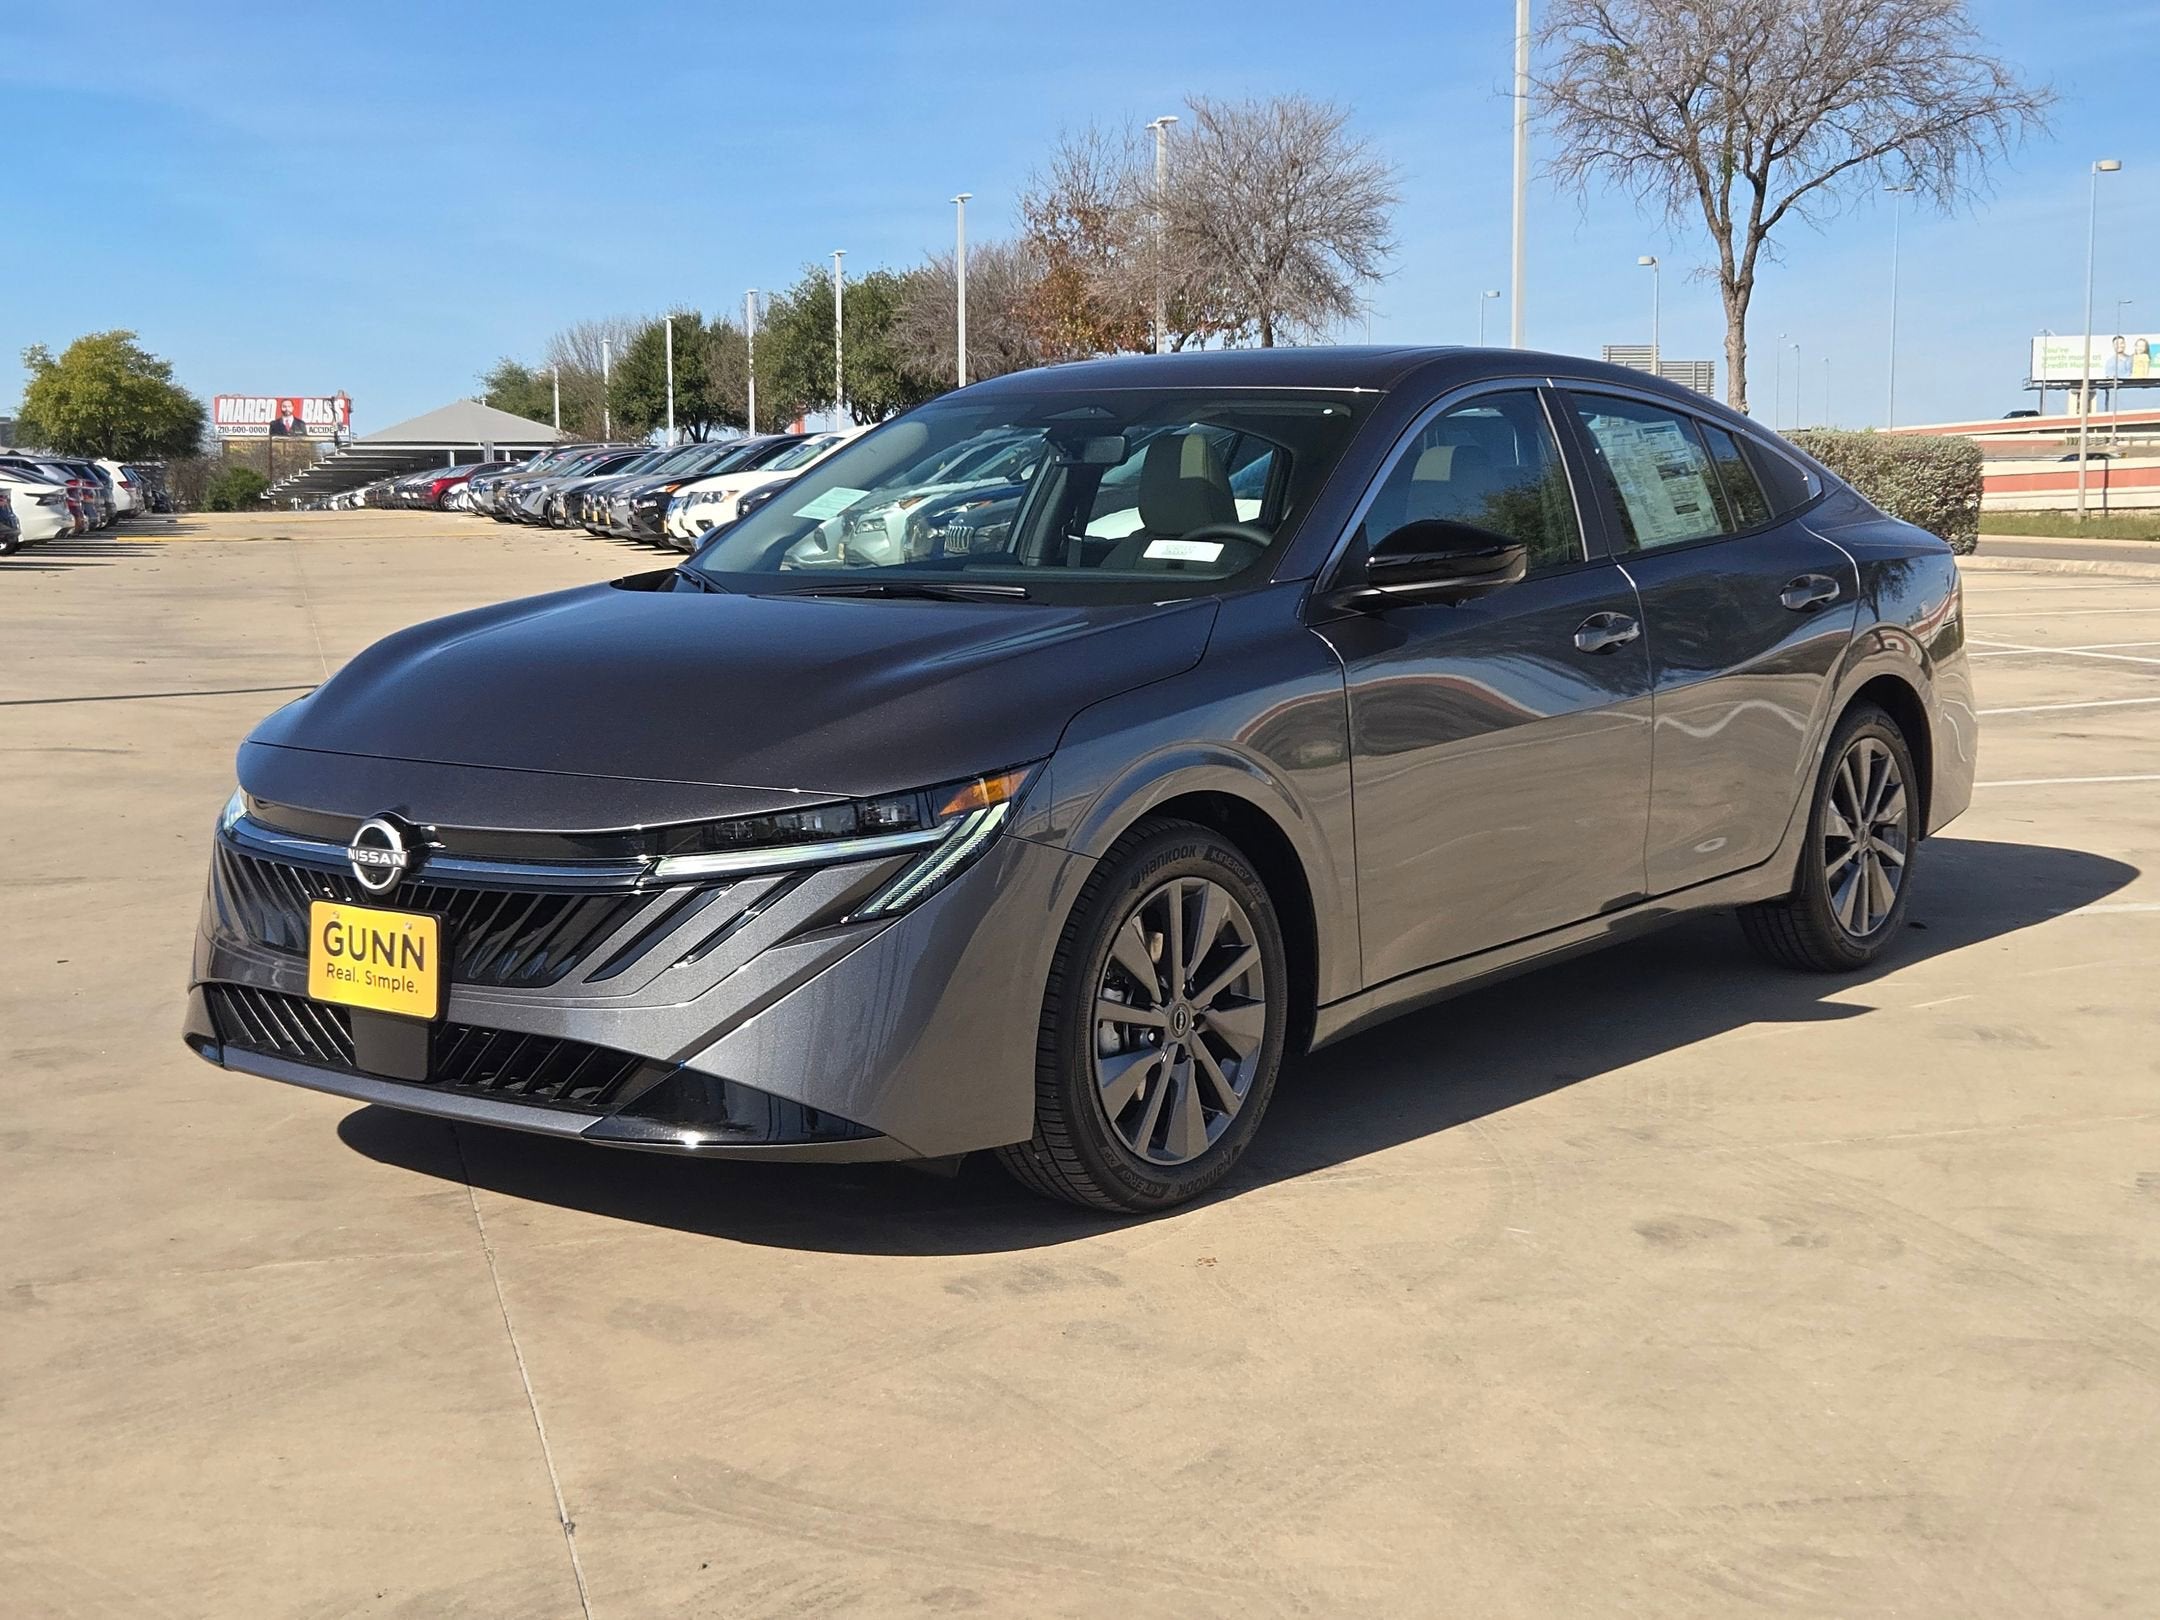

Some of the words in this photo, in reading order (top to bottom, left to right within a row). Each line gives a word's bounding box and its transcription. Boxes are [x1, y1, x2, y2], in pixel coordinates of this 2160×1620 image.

[218, 399, 277, 423] MARCO
[301, 399, 345, 423] BASS
[218, 426, 268, 434] 210-600-0000
[348, 848, 407, 867] NISSAN
[1211, 848, 1251, 880] KINERGY
[323, 920, 425, 972] GUNN
[326, 963, 360, 984] Real.
[365, 970, 419, 994] Simple.
